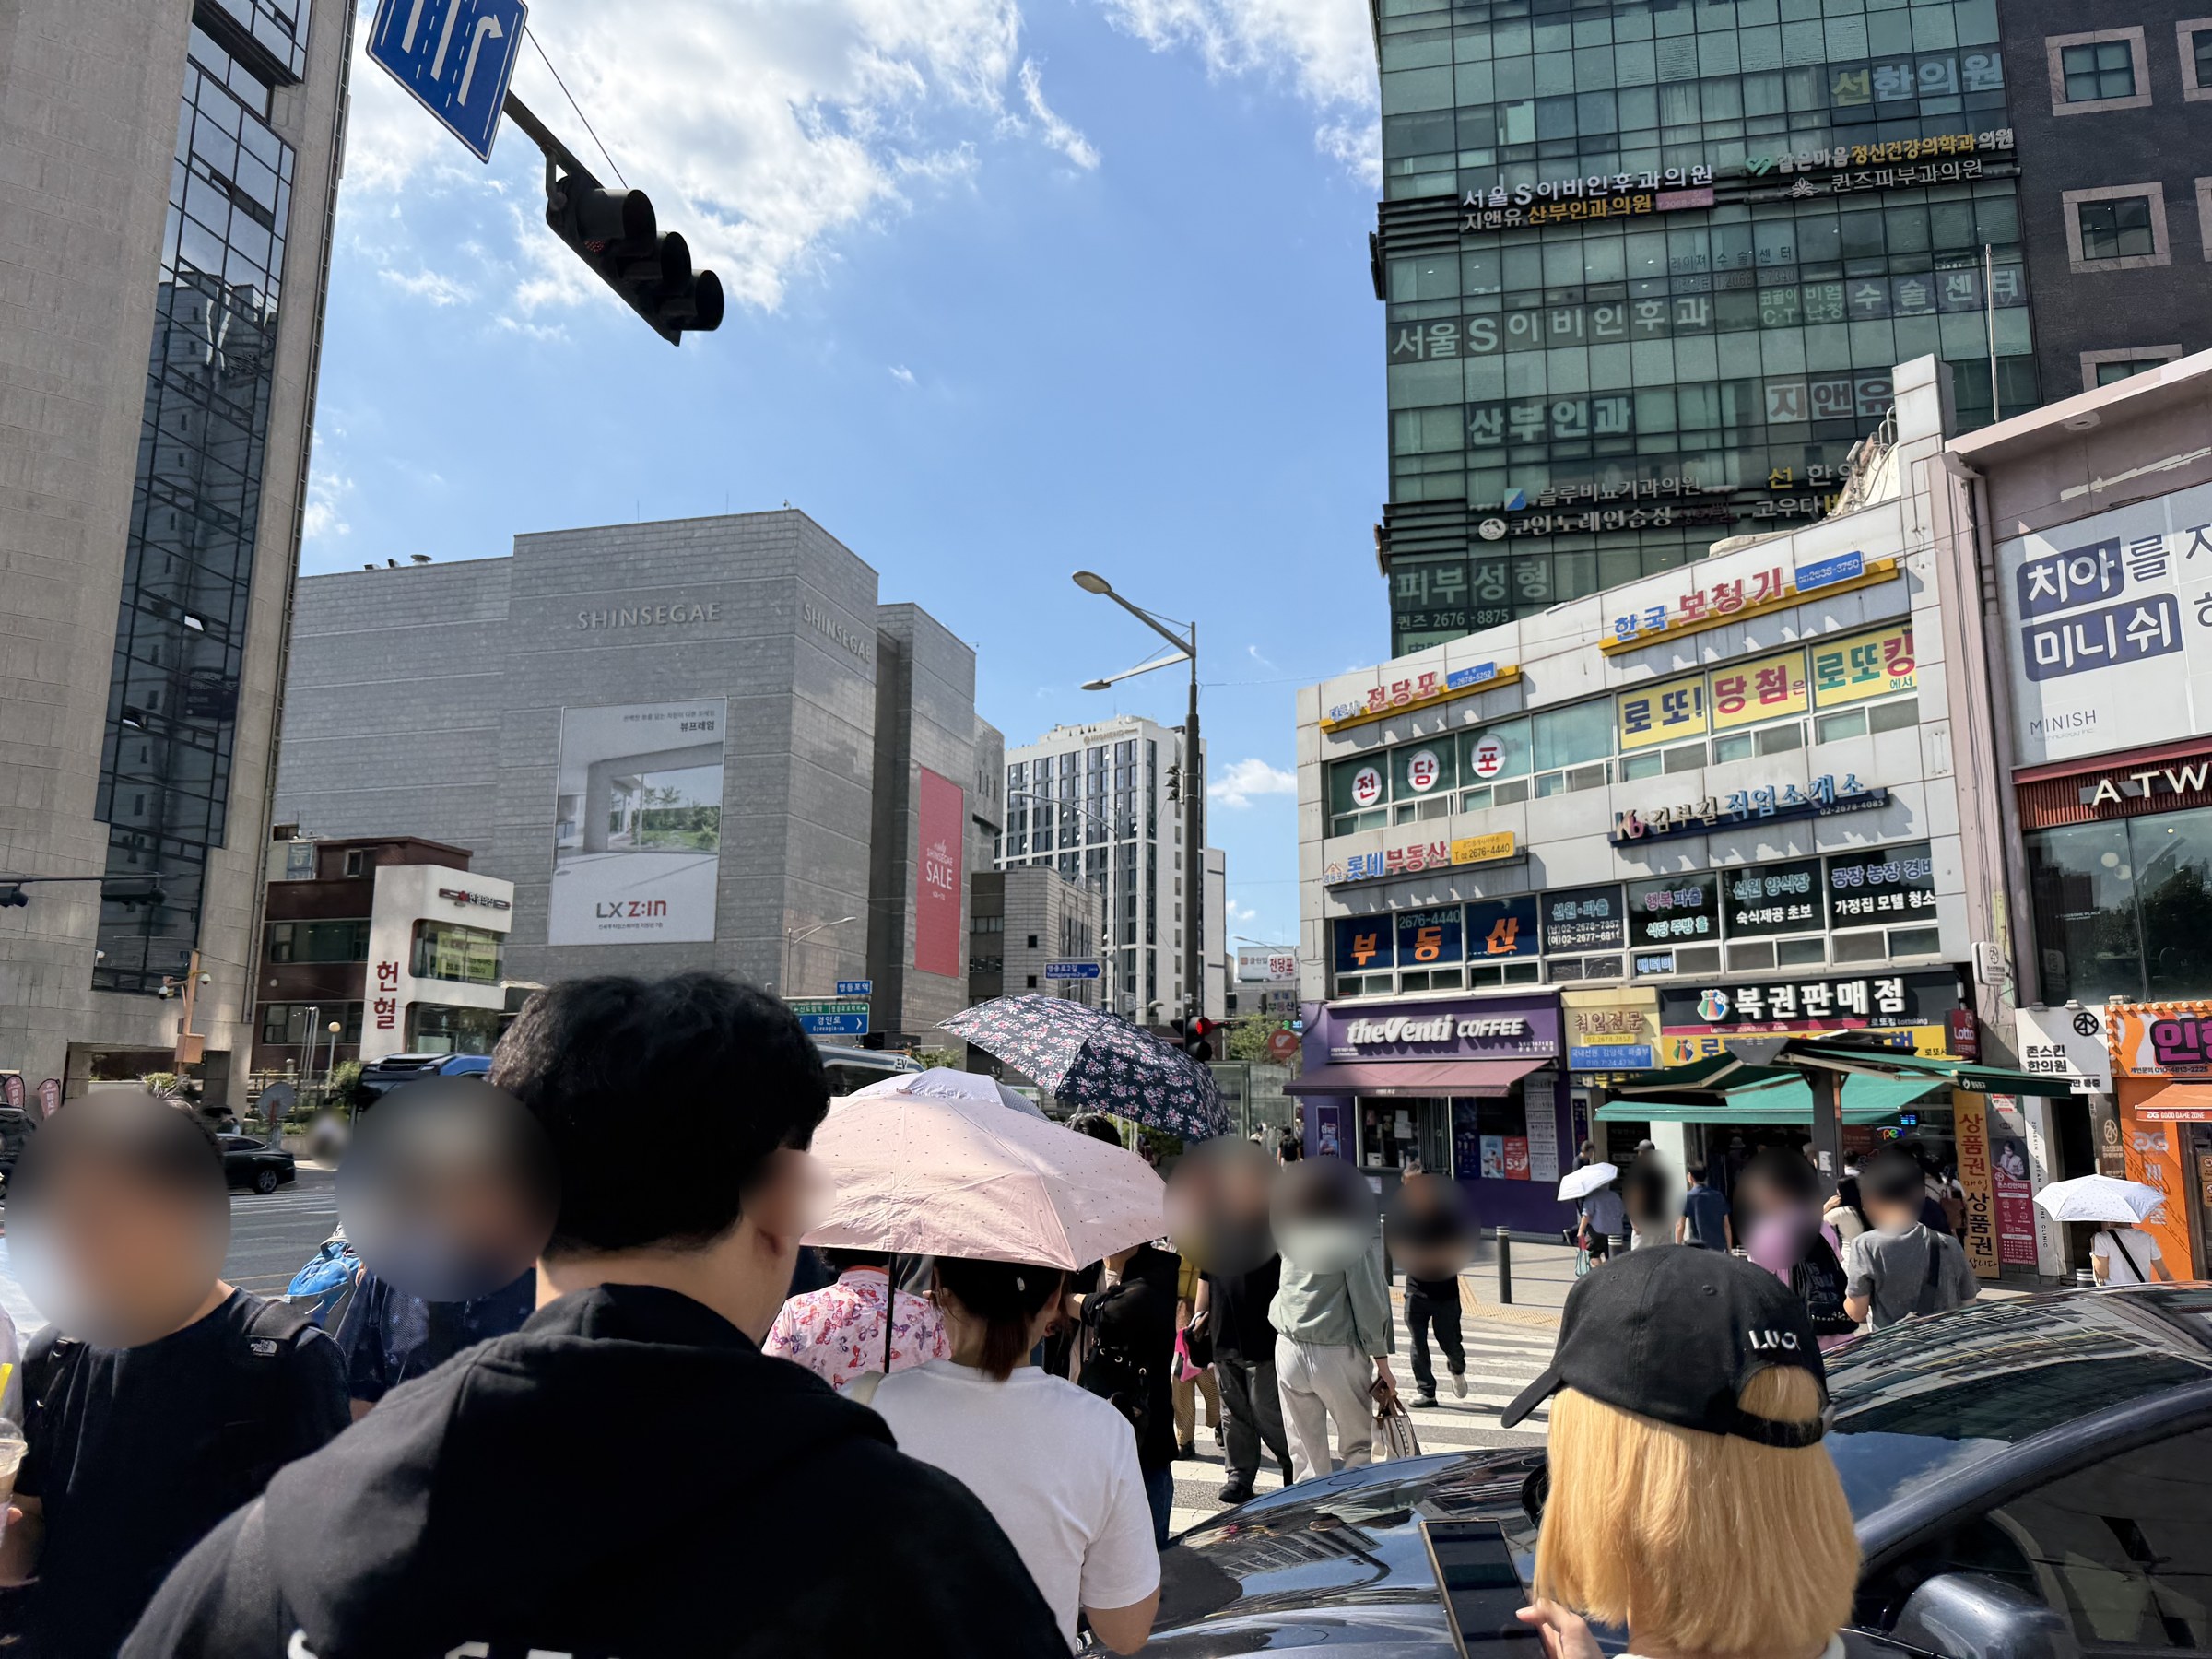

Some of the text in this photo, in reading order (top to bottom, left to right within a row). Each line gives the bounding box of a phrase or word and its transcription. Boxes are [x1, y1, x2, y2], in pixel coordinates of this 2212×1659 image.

[1832, 53, 2005, 107] 선한의원
[1463, 164, 1713, 209] 서울S이비인후과의원
[1831, 159, 1983, 193] 퀸즈피부과의원
[1463, 194, 1652, 231] 지앤유 산부인과의원
[1806, 285, 1842, 301] 비염
[1854, 270, 2017, 310] 수술센터
[1806, 302, 1843, 321] 난청
[1392, 296, 1710, 359] 서울S이비인후과
[1770, 379, 1892, 418] 지앤유
[1468, 395, 1630, 445] 산부인과
[1538, 476, 1701, 507] 블루비뇨기과의원
[1769, 467, 1793, 489] 선
[1509, 506, 1672, 536] 코인노래연습장
[2027, 534, 2171, 603] 치아를
[1396, 560, 1547, 606] 피부성형
[577, 602, 722, 630] SHINSEGAE
[1614, 605, 1666, 642] 한국
[1678, 567, 1783, 625] 보청기
[804, 603, 871, 664] SHINSEGAE
[1396, 615, 1428, 630] 퀸즈
[2034, 602, 2171, 669] 미니쉬
[1367, 671, 1440, 713] 전당포
[1624, 686, 1703, 735] 로또!
[1817, 634, 1914, 691] 로또킹
[1889, 676, 1912, 690] 에서
[680, 721, 715, 732] 뷰프레임
[2030, 709, 2097, 735] MINISH
[1725, 774, 1862, 824] 직업소개소
[1347, 841, 1447, 882] 롯데부동산
[1469, 843, 1510, 860] 2676-4440
[926, 861, 953, 890] SALE
[1734, 873, 1810, 900] 선원 양식장
[1832, 865, 1864, 888] 공장
[1867, 861, 1900, 884] 농장
[596, 902, 624, 918] LX
[1645, 887, 1702, 911] 행복파출
[1835, 890, 1936, 915] 가정집 모텔 청소
[1398, 911, 1461, 929] 2676-4440
[1646, 921, 1669, 938] 식당
[1670, 917, 1694, 935] 주방
[1736, 903, 1813, 925] 숙식제공 초보
[1270, 959, 1294, 973] 전당포
[373, 961, 399, 1030] 헌혈
[839, 982, 869, 992] 영등포역
[1735, 978, 1909, 1019] 복권판매점
[1268, 1001, 1295, 1012] 부동산
[818, 1016, 841, 1026] 경인로
[1457, 1018, 1524, 1038] COFFEE
[1954, 1027, 1975, 1041] Lotto
[2026, 1044, 2065, 1059] 존스킨
[2027, 1059, 2067, 1073] 한의원
[1959, 1113, 1986, 1177] 상품권
[1967, 1192, 1993, 1256] 상품권
